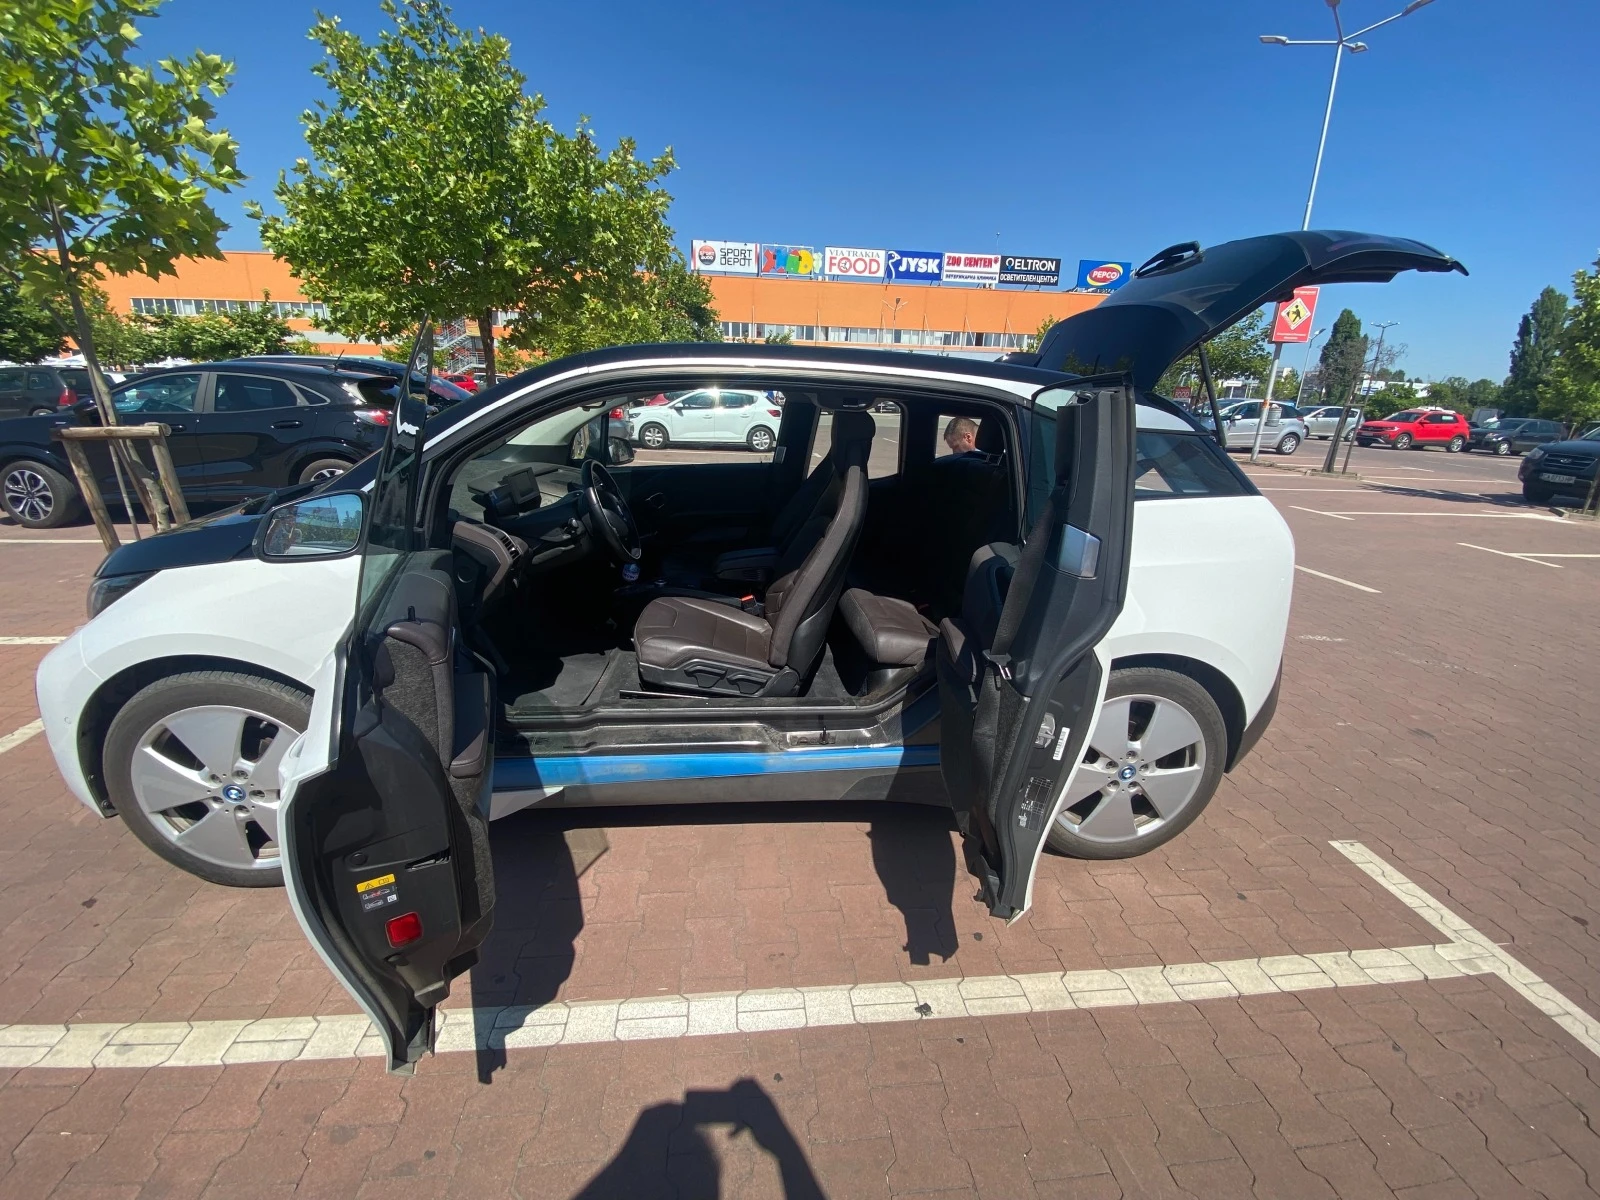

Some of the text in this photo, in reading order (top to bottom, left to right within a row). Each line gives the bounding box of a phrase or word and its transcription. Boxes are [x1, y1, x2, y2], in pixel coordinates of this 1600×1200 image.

[720, 248, 752, 258] SPORT
[829, 249, 880, 258] VIA TRAKIA
[720, 257, 752, 267] DEPOT
[829, 256, 880, 274] FOOD
[898, 257, 941, 274] JYSK
[946, 256, 993, 268] ZOO CENTER
[1000, 273, 1058, 284] ОСВЕТИТЕЛЕН ЦЕНТЪР
[1092, 270, 1118, 279] PEPCO
